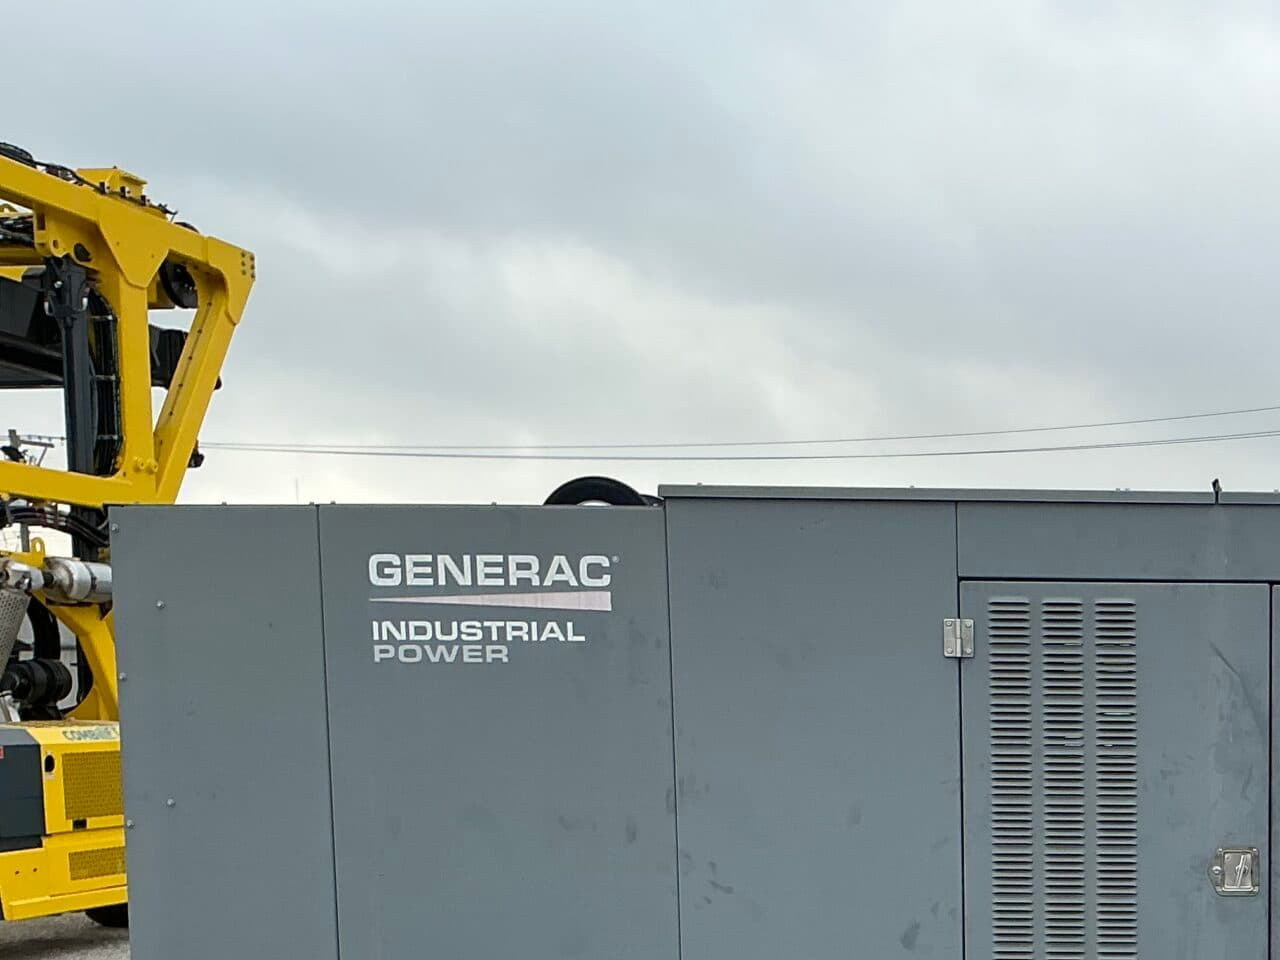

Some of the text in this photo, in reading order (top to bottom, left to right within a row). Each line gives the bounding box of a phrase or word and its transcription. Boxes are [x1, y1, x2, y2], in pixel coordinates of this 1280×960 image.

[368, 553, 612, 588] GENERAC
[372, 620, 586, 642] INDUSTRIAL
[373, 644, 509, 663] POWER
